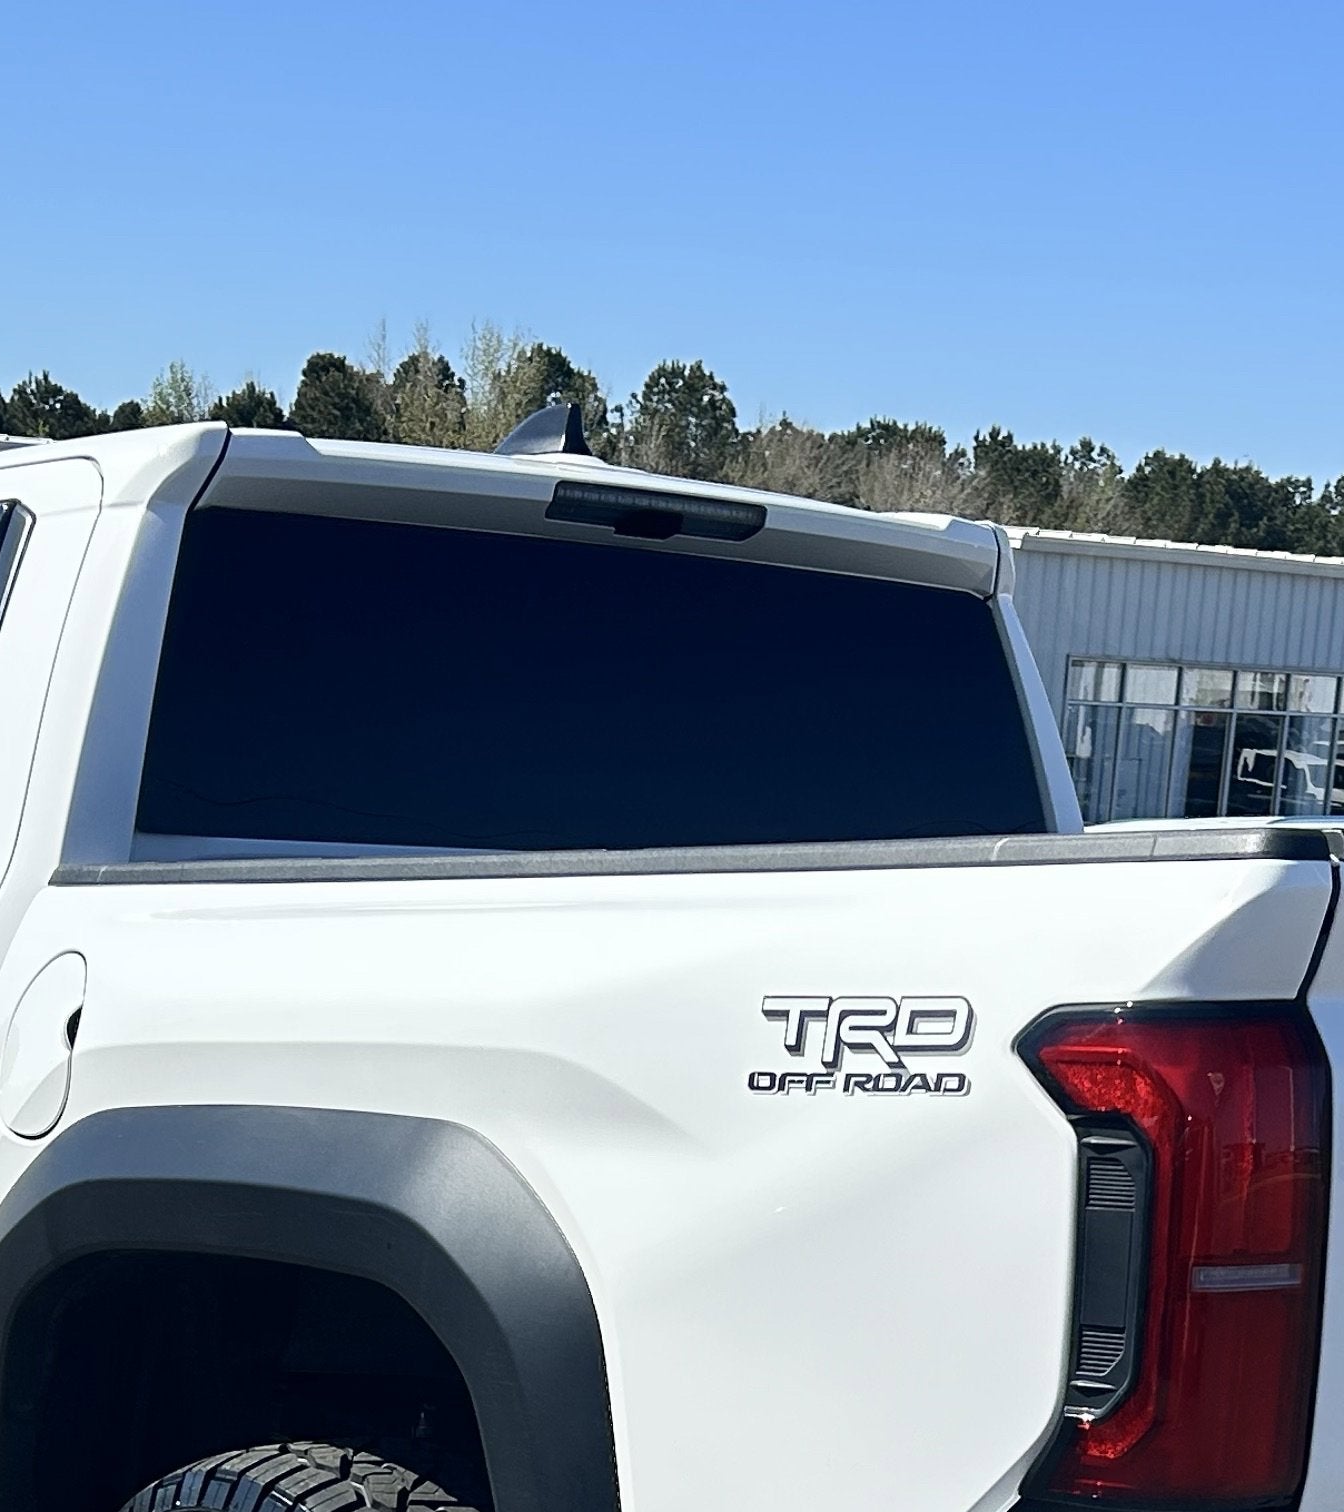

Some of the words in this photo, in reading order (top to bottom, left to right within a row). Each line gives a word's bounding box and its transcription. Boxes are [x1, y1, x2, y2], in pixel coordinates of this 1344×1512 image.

[761, 995, 975, 1068] TRD
[748, 1071, 837, 1096] OFF
[843, 1072, 972, 1097] ROAD
